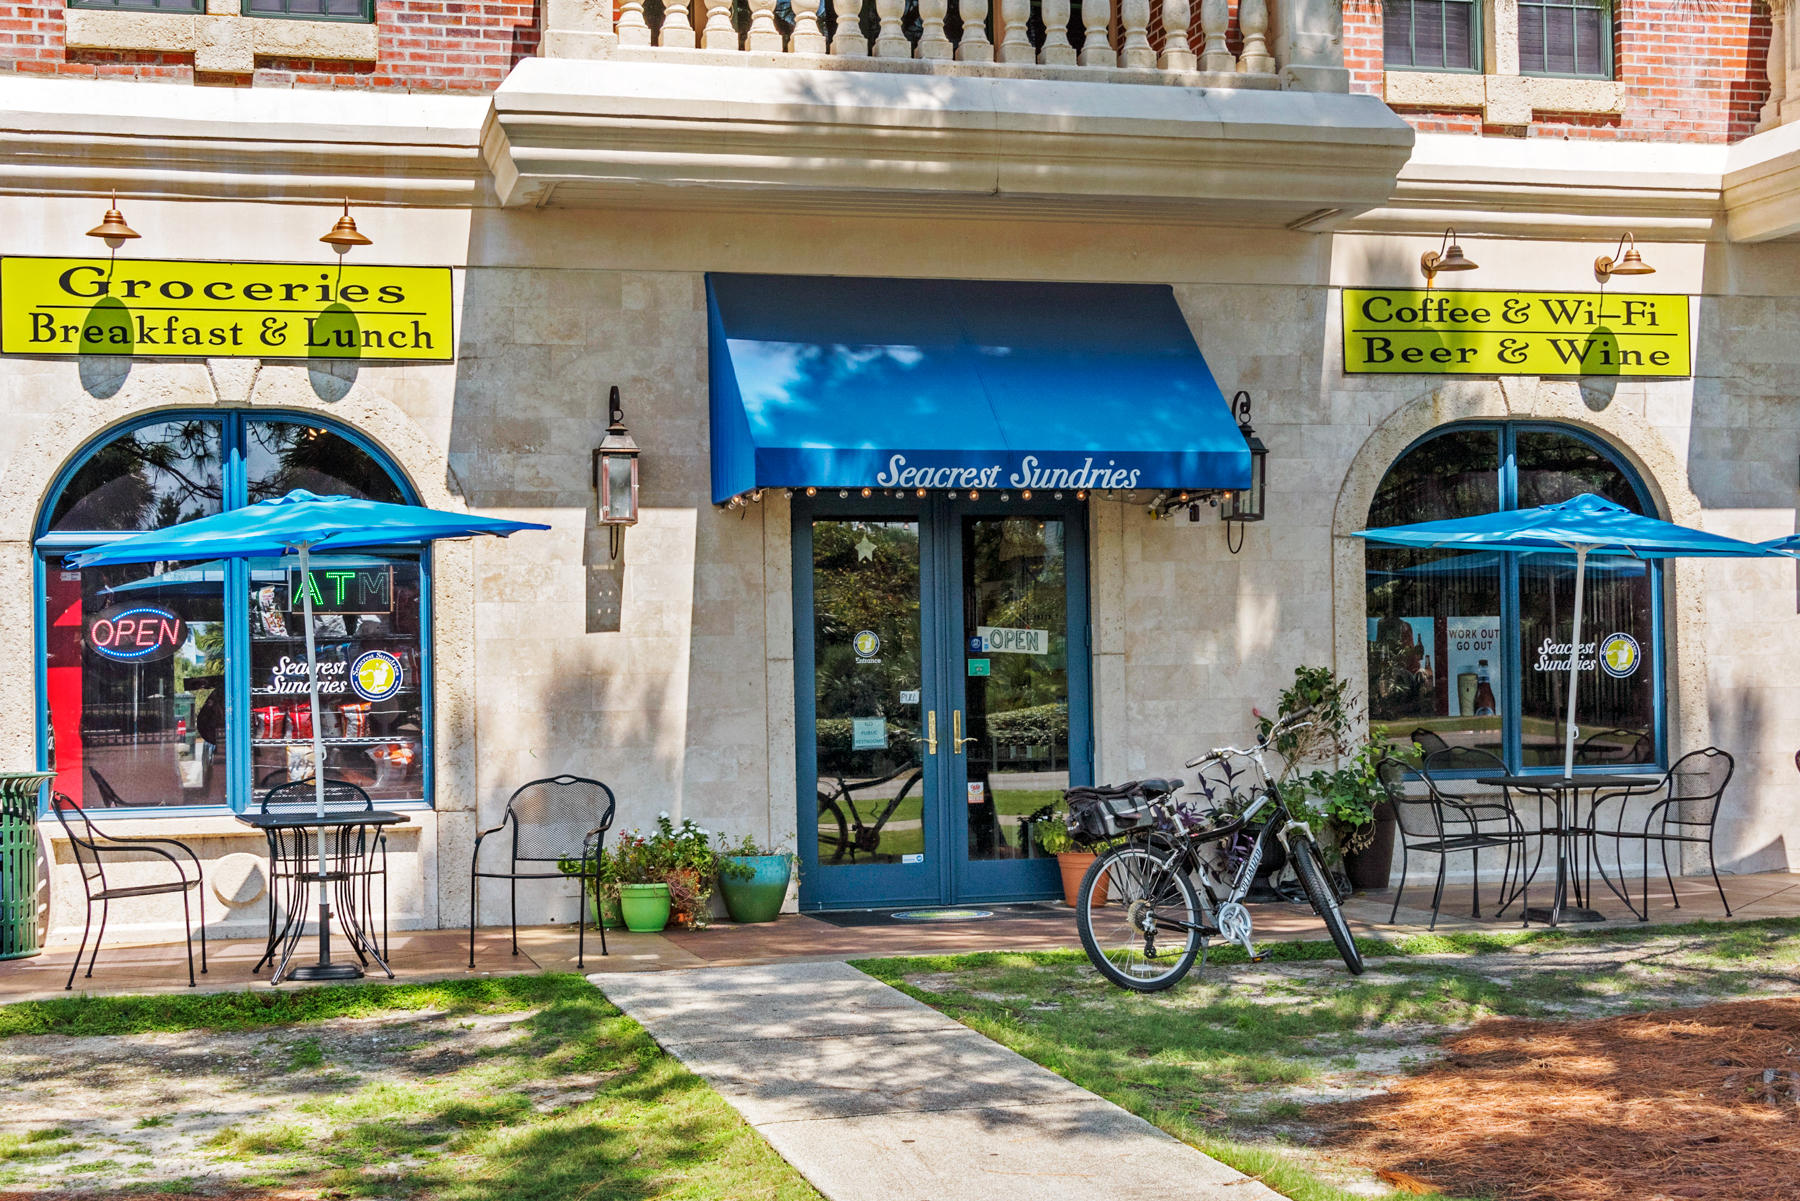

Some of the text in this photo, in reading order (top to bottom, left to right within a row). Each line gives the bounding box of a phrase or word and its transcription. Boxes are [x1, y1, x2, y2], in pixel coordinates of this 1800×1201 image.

[59, 266, 405, 303] Groceries
[1361, 296, 1491, 324] Coffee
[1501, 298, 1531, 324] &
[29, 312, 434, 349] Breakfast & Lunch
[1362, 336, 1670, 366] Beer & Wine
[877, 454, 1141, 489] Seacrest Sundries
[293, 571, 390, 606] ATM
[91, 618, 180, 647] OPEN
[990, 629, 1039, 651] OPEN
[1449, 629, 1499, 639] WORK OUT
[1456, 641, 1492, 651] GO OUT
[1537, 637, 1596, 655] Seacest
[1533, 655, 1597, 671] Sundies
